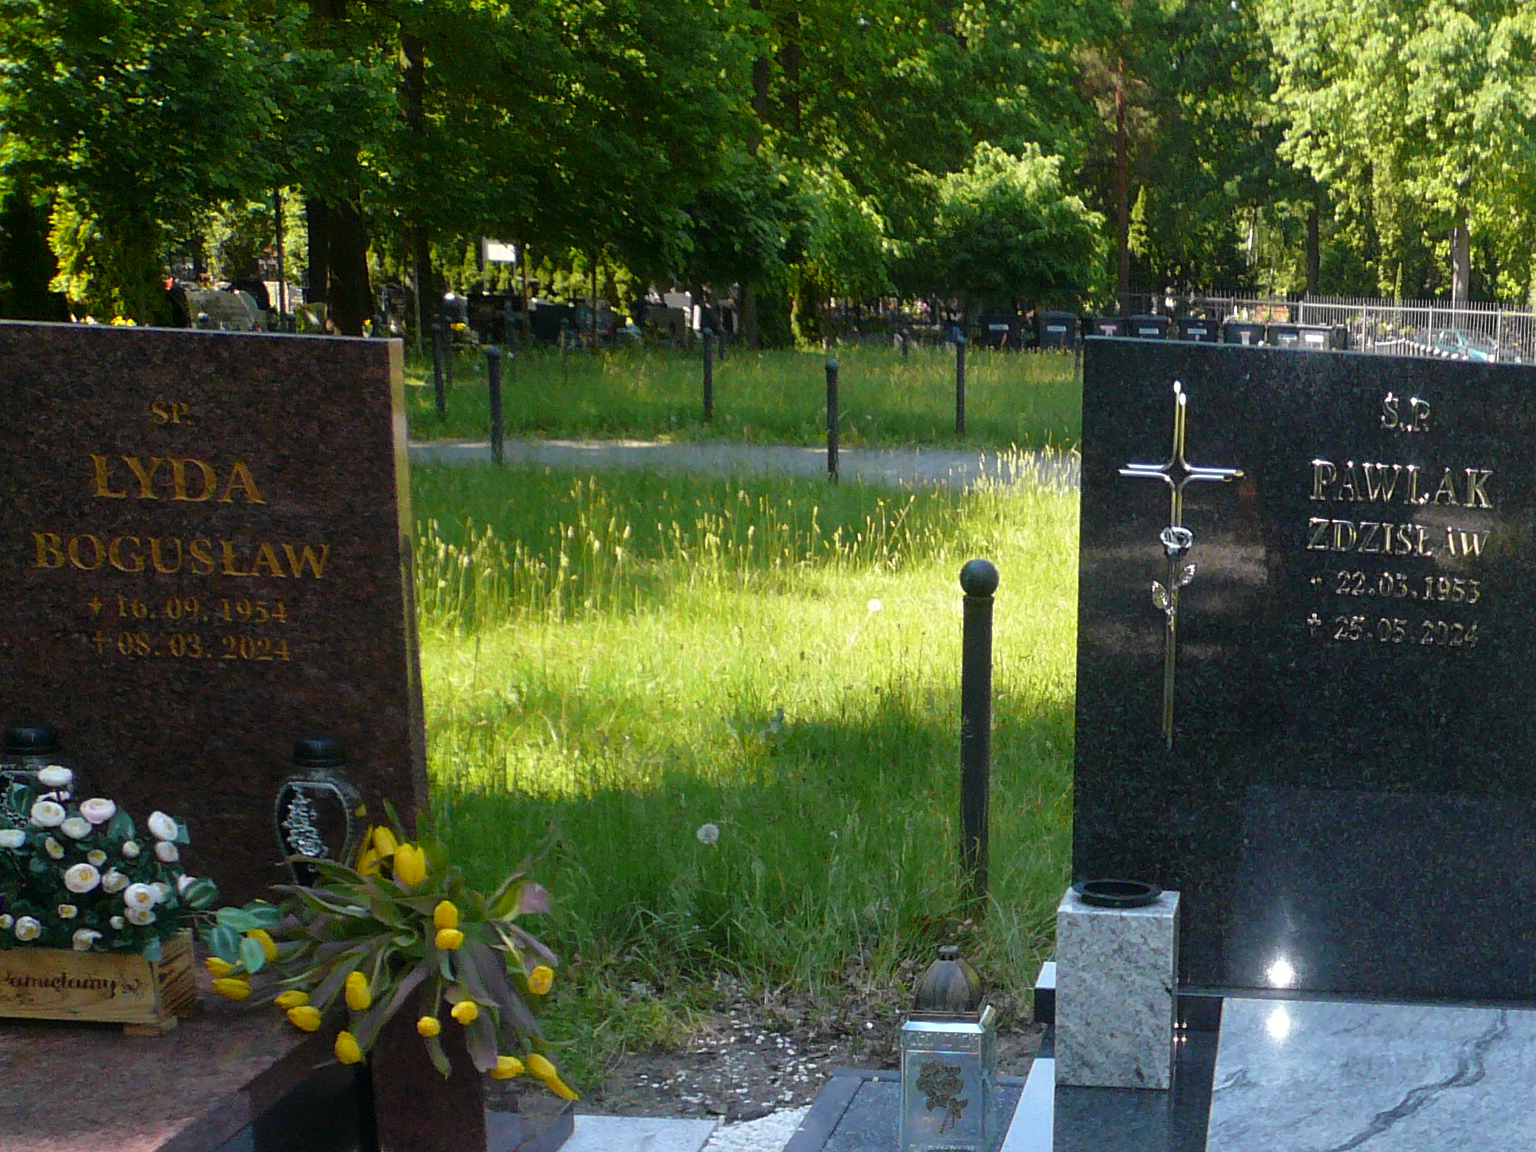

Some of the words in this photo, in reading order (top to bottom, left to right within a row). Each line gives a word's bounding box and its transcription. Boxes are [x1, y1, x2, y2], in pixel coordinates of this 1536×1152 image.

[90, 453, 266, 505] ŁYDA
[1308, 458, 1494, 509] PAWLAK
[31, 531, 331, 579] BOGUSŁAW
[1306, 516, 1491, 556] ZDZISŁAW
